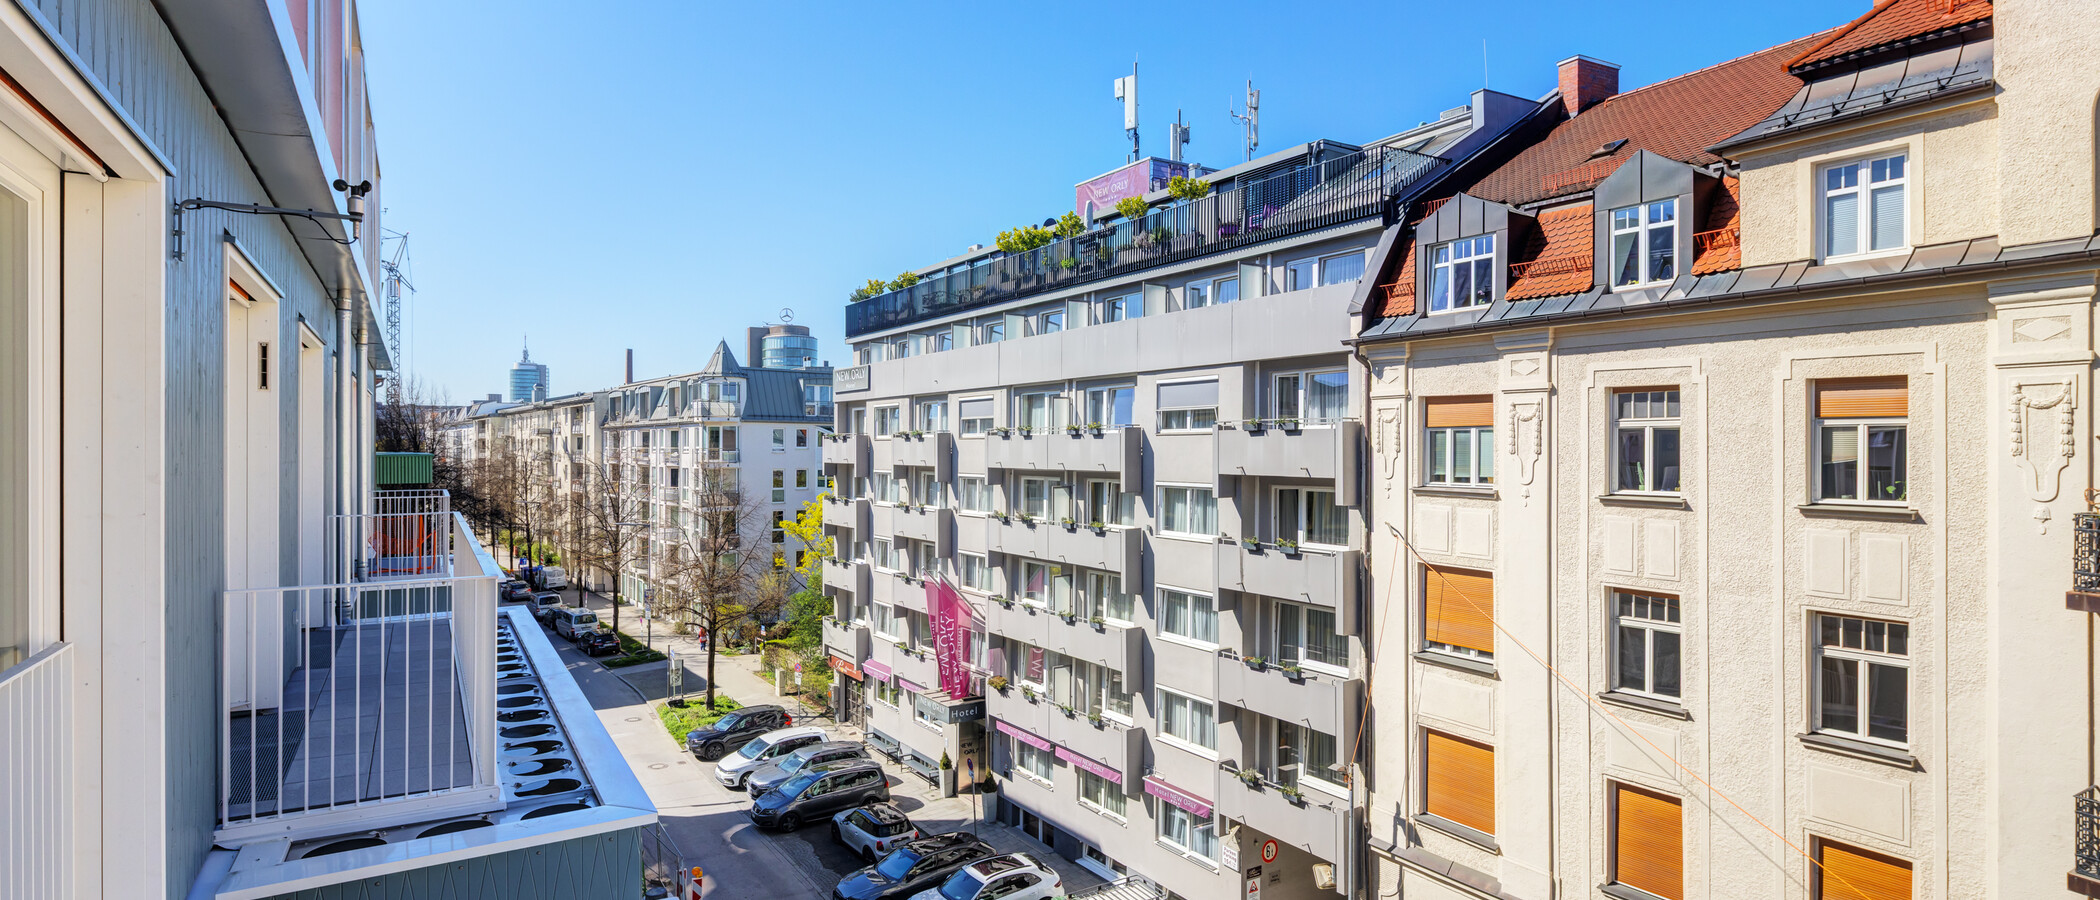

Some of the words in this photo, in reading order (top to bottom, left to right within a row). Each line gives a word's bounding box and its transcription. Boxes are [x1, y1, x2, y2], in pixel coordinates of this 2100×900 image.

[1094, 187, 1109, 199] NEW
[1111, 179, 1129, 192] ORLY
[836, 371, 850, 382] NEW
[851, 368, 866, 380] ORLY
[951, 706, 978, 718] Hotel
[1154, 786, 1169, 797] Hotel
[1170, 792, 1182, 803] NEW
[1183, 798, 1198, 809] ORLY
